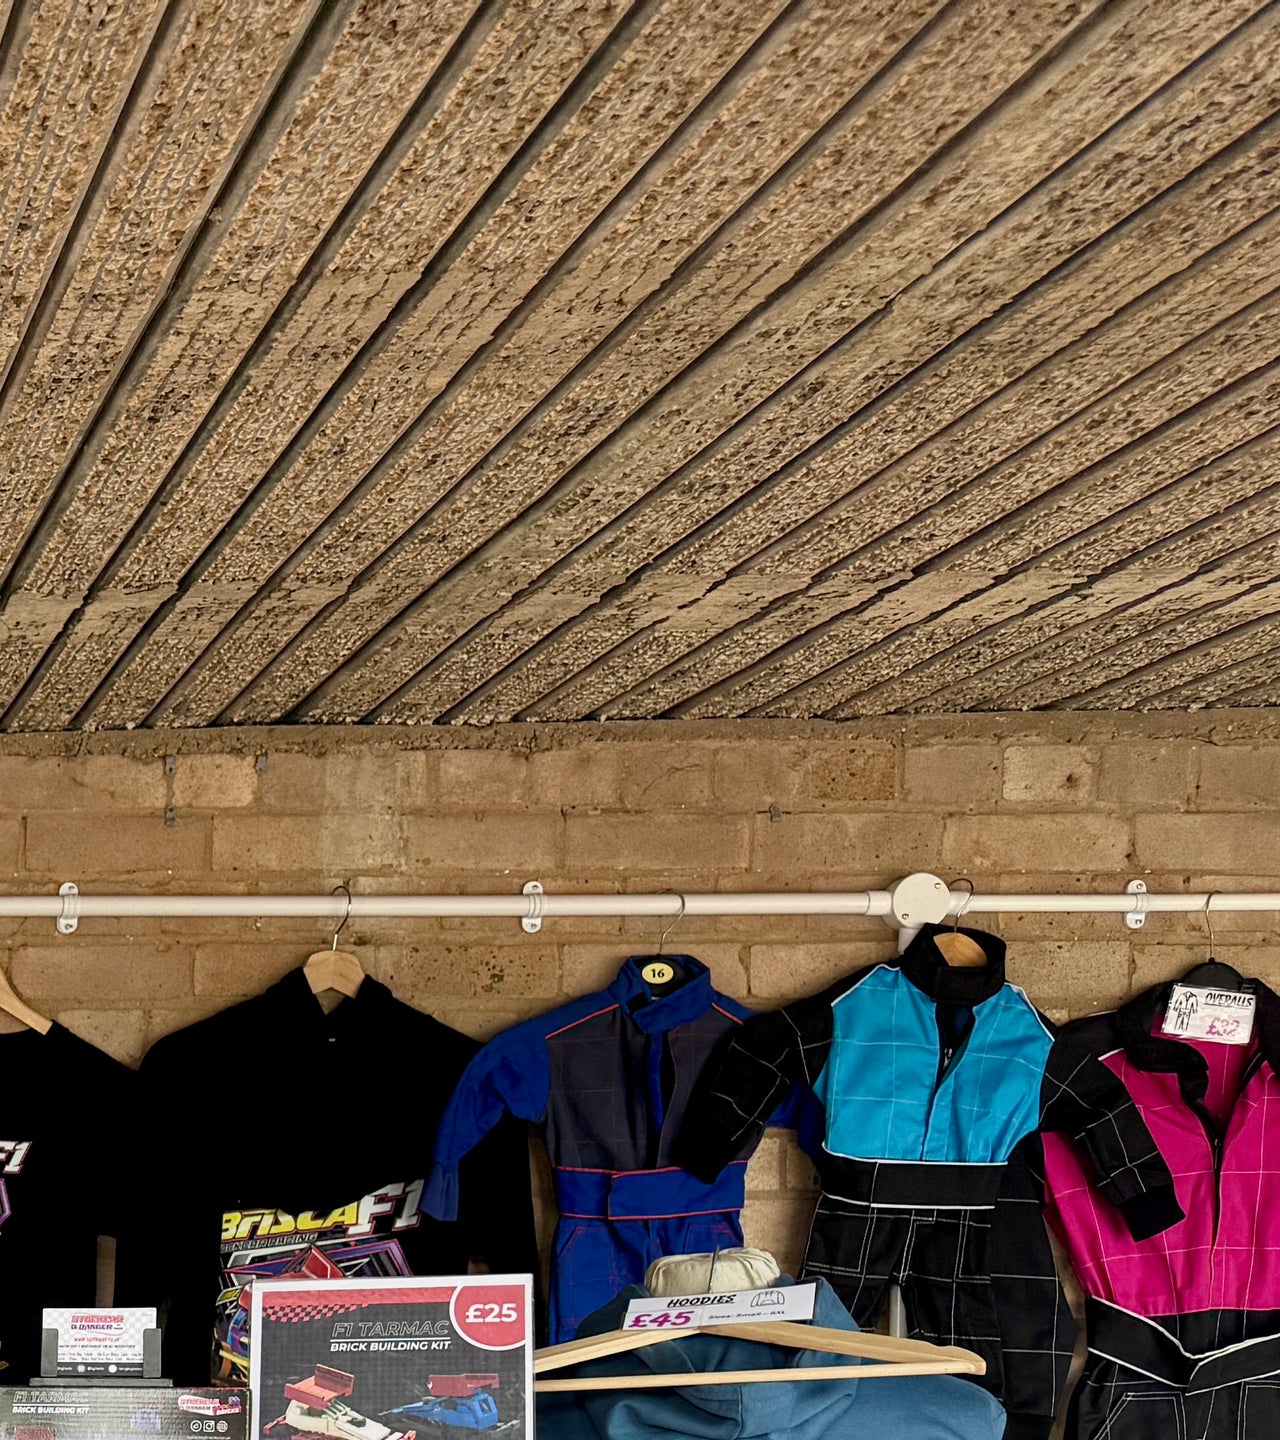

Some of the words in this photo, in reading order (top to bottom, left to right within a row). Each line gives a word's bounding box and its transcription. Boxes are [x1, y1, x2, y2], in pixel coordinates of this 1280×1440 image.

[666, 1294, 737, 1308] HOODIES
[465, 1303, 518, 1324] £25
[628, 1310, 695, 1328] £45
[331, 1321, 359, 1338] F1
[359, 1320, 451, 1337] TARMAC
[330, 1342, 364, 1352] BRICK
[366, 1341, 428, 1352] BUILDING
[430, 1340, 452, 1350] KIT
